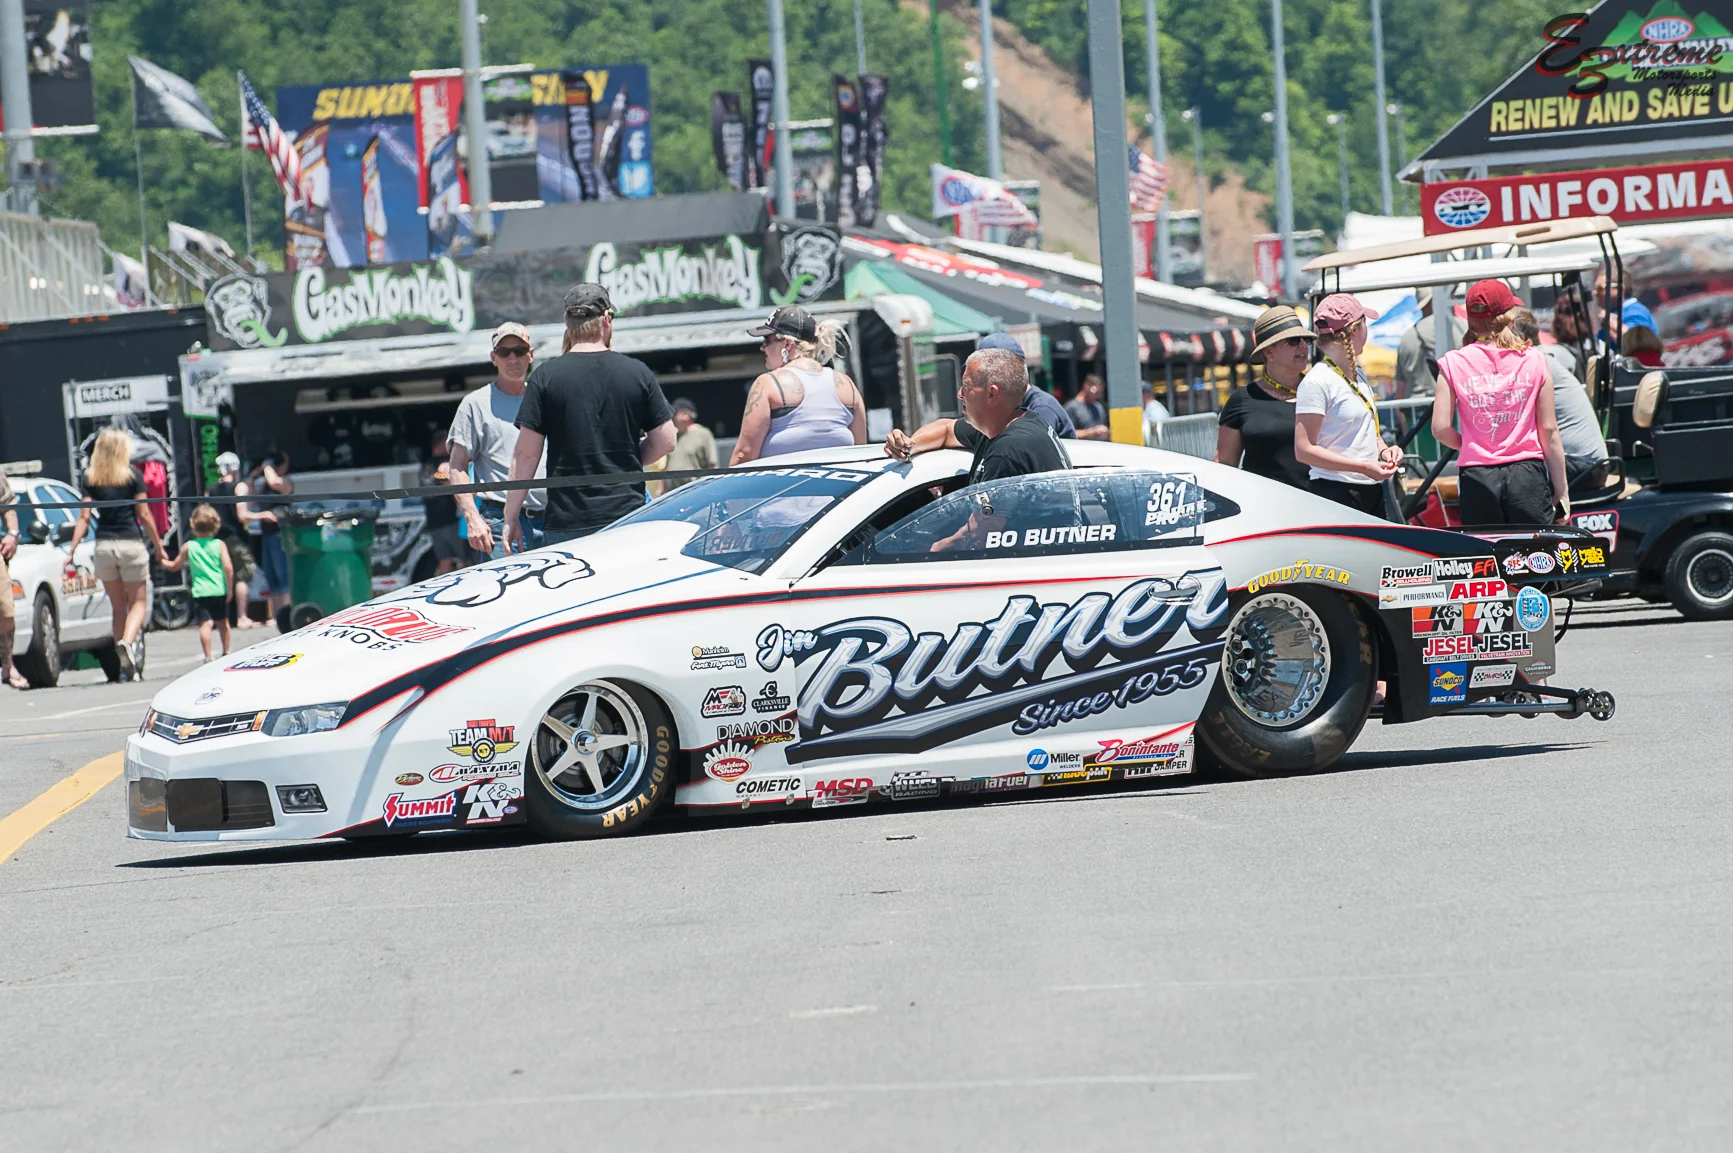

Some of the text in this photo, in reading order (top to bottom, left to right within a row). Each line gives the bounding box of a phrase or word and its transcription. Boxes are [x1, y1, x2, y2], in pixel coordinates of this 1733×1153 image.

[1644, 19, 1690, 39] NHRA
[1489, 95, 1581, 133] RENEW
[1586, 90, 1640, 126] AND
[1646, 82, 1711, 121] SAVE
[1501, 168, 1733, 222] INFORMA
[81, 384, 131, 403] MERCH
[1147, 481, 1187, 512] 361
[1576, 513, 1613, 531] FOX
[985, 524, 1117, 549] BO BUTNER
[1382, 564, 1432, 579] Browell
[1434, 560, 1473, 579] Holley
[1403, 591, 1445, 601] PERFORMANCE
[1449, 580, 1506, 600] ARP
[756, 623, 818, 673] Jim
[798, 567, 1229, 734] Butner
[1424, 636, 1474, 657] JESEL
[1480, 632, 1529, 653] JESEL
[1433, 676, 1463, 686] SUNOCO
[752, 697, 790, 708] CLARKSVILLE
[1011, 657, 1208, 736] Since 1955
[449, 726, 515, 746] TEAM M/T
[717, 718, 795, 741] DIAMOND
[753, 733, 794, 745] Pistons
[714, 758, 747, 771] Golden
[1050, 752, 1080, 764] Miller
[717, 767, 745, 775] Shine
[736, 777, 801, 794] COMETIC
[814, 777, 874, 798] MSD
[894, 789, 939, 798] RACING
